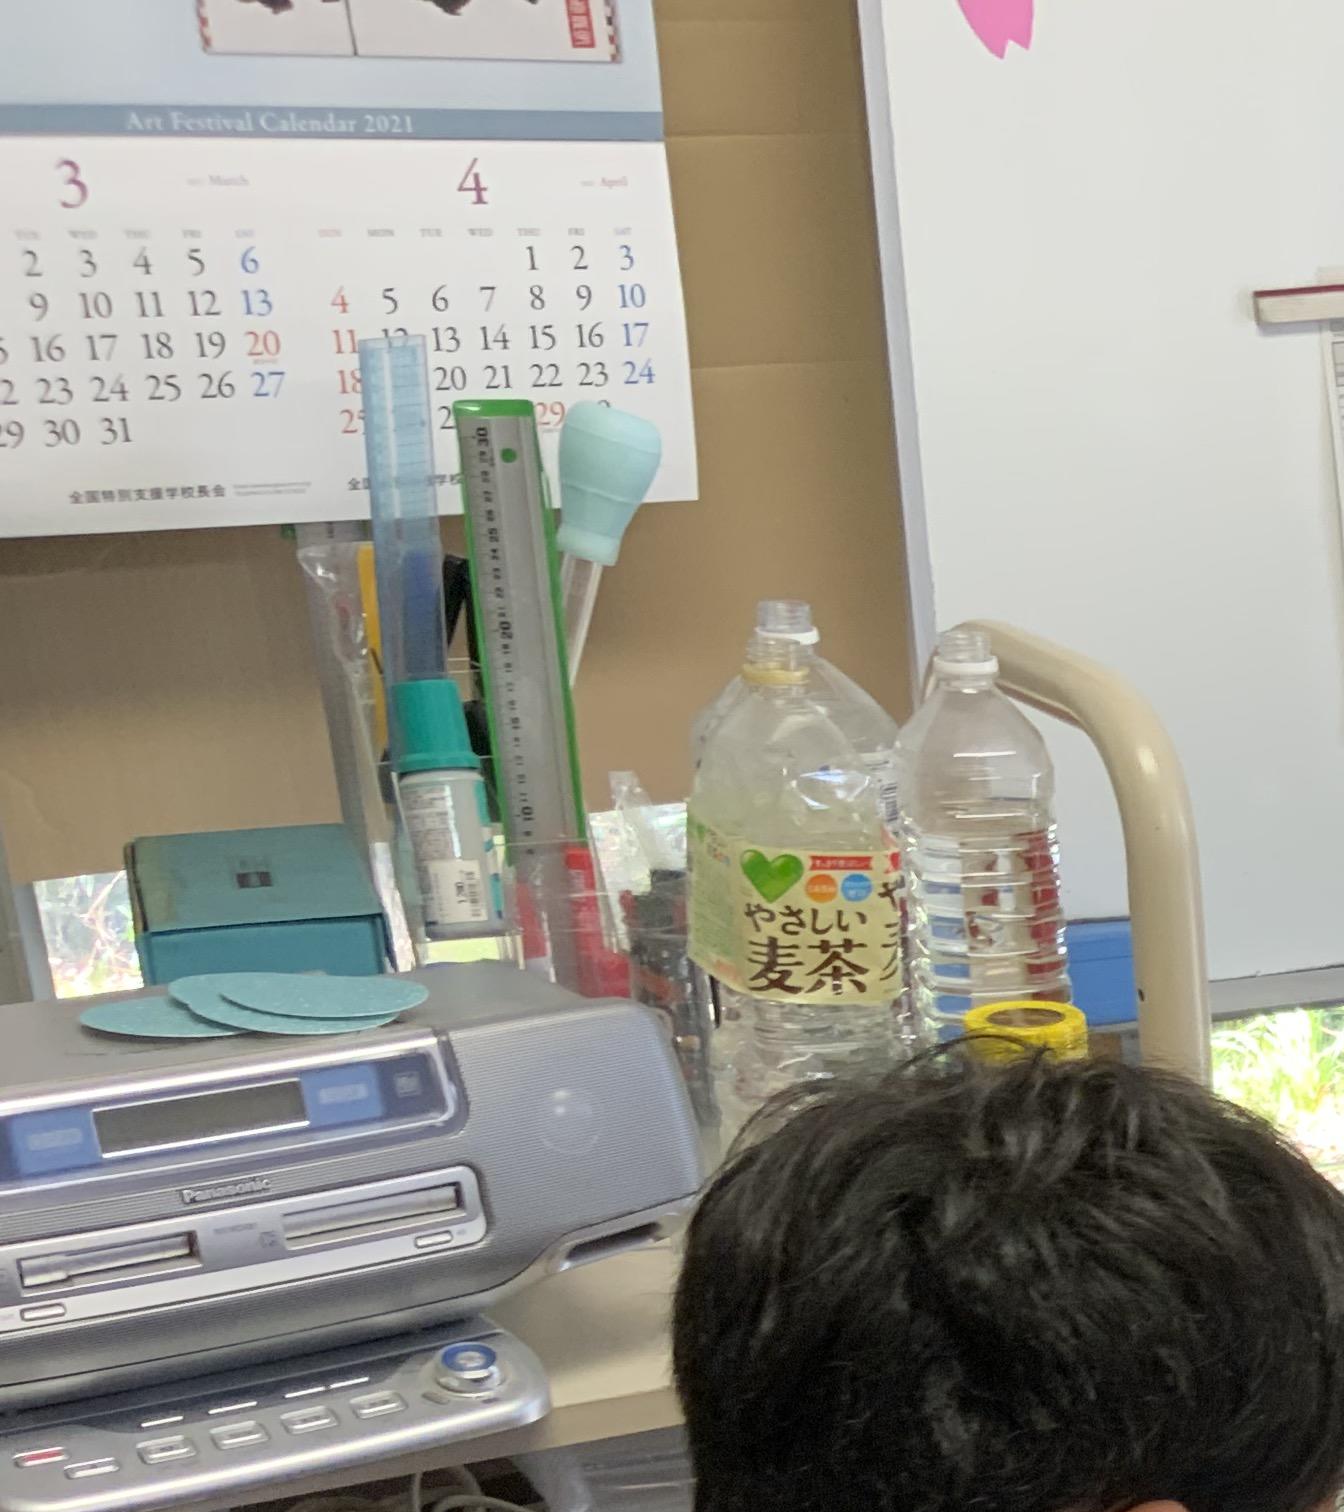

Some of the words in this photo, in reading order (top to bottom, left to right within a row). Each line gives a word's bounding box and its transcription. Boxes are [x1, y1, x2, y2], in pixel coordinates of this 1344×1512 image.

[127, 112, 163, 130] Art
[172, 112, 250, 132] Festival
[260, 114, 357, 133] Calendar
[364, 114, 414, 133] 2021
[57, 159, 88, 208] 3
[457, 158, 488, 204] 4
[24, 250, 42, 277] 2
[80, 250, 96, 277] 3
[132, 246, 153, 275] 4
[188, 249, 205, 275] 5
[241, 247, 259, 274] 6
[526, 246, 538, 270] 1
[572, 246, 588, 270] 2
[620, 245, 634, 270] 3
[29, 293, 48, 321] 9
[79, 292, 112, 319] 10
[135, 291, 164, 317] 11
[188, 290, 221, 316] 12
[242, 289, 272, 316] 13
[331, 288, 349, 313] 4
[383, 288, 398, 314] 5
[432, 285, 448, 312] 6
[480, 286, 496, 310] 7
[530, 285, 545, 310] 8
[576, 285, 592, 310] 9
[618, 284, 645, 308] 10
[30, 334, 65, 362] 16
[86, 334, 117, 360] 17
[141, 332, 173, 359] 18
[195, 332, 225, 358] 19
[245, 330, 280, 356] 20
[432, 327, 460, 352] 13
[480, 325, 509, 350] 14
[530, 325, 556, 350] 15
[577, 322, 603, 347] 16
[623, 323, 648, 346] 17
[37, 377, 73, 405] 23
[91, 376, 128, 402] 24
[146, 375, 181, 401] 25
[199, 371, 235, 398] 26
[251, 372, 285, 397] 27
[434, 366, 466, 390] 20
[484, 365, 512, 389] 21
[530, 364, 562, 387] 22
[578, 362, 608, 387] 23
[624, 361, 655, 384] 24
[45, 419, 80, 447] 30
[102, 418, 132, 445] 31
[69, 484, 226, 504] 全国特別支援学校長会
[744, 903, 867, 935] やさしい
[748, 936, 870, 995] 麦茶
[182, 1178, 271, 1203] Panasonic
